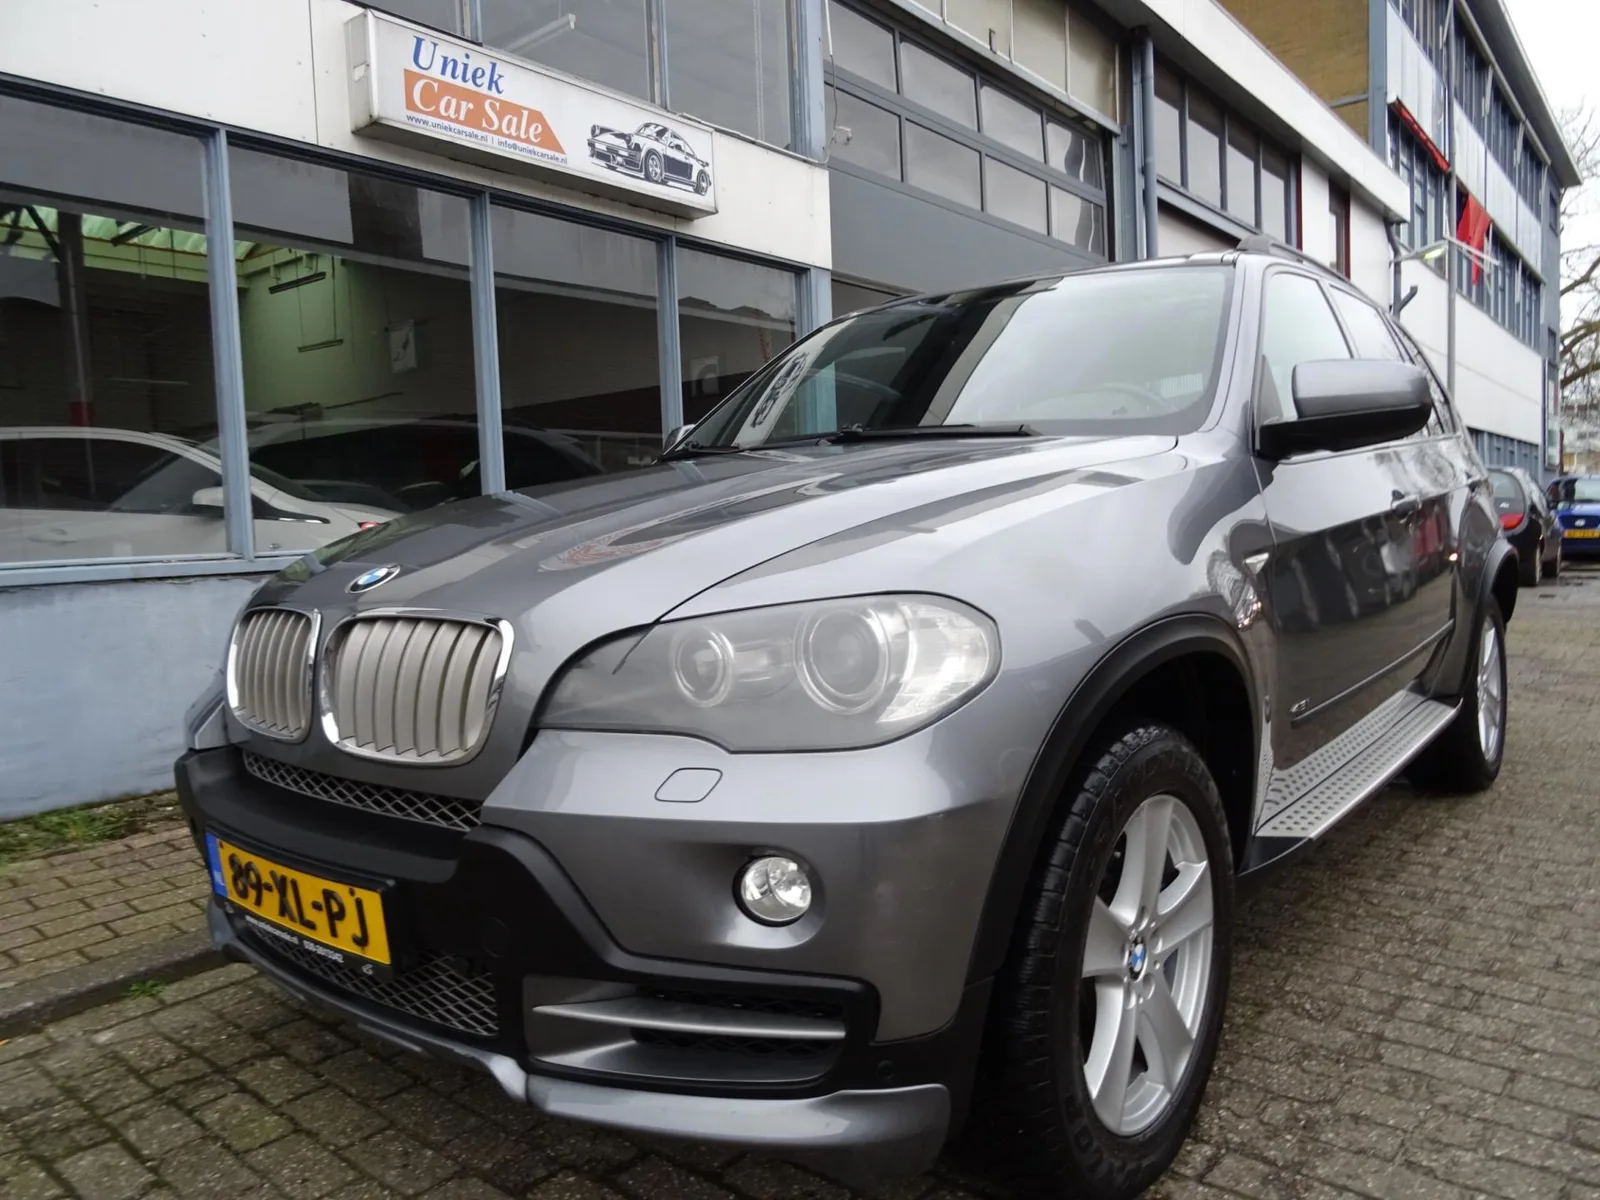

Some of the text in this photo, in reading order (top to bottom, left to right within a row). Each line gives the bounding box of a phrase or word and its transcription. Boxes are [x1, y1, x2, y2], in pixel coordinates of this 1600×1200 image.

[412, 35, 504, 94] Uniek
[406, 114, 568, 164] www.uniekcarsale.nl info@uniekcarsale.nl
[413, 79, 542, 142] Car Sale
[228, 853, 370, 947] 89-XL-PJ
